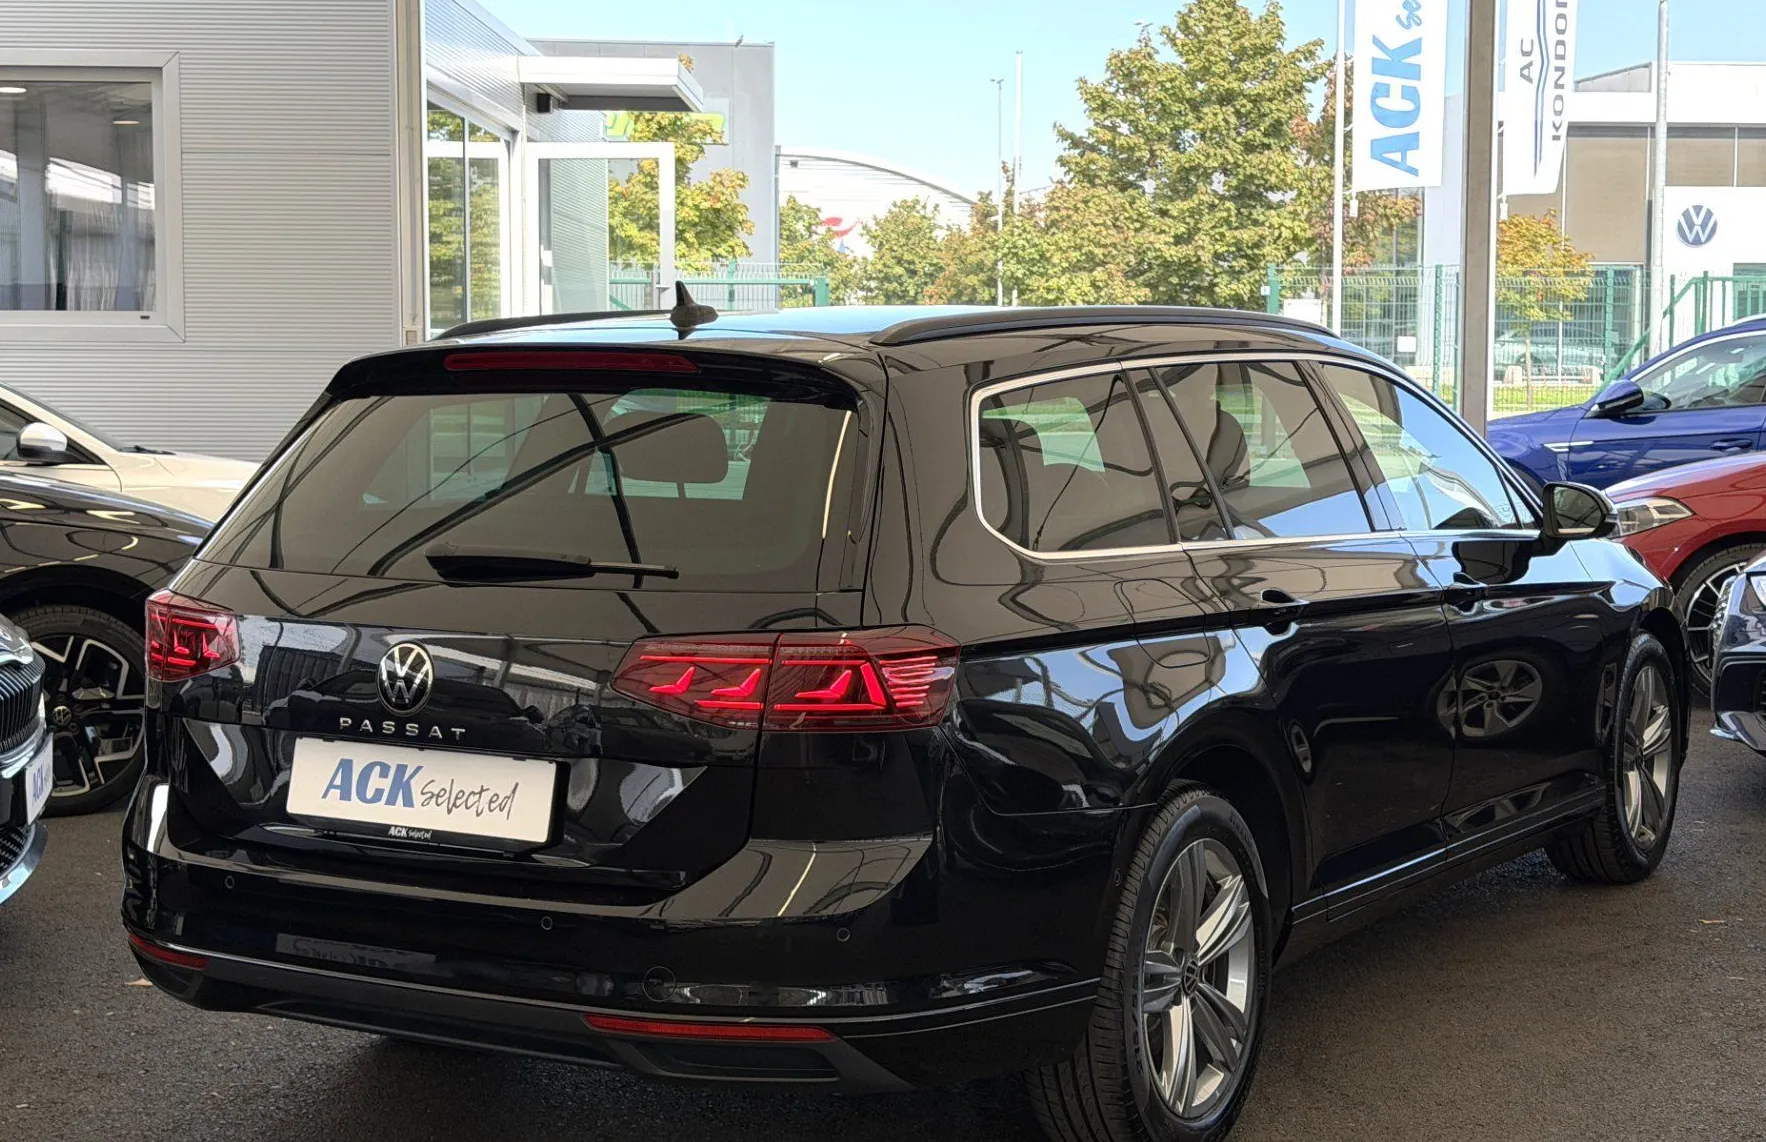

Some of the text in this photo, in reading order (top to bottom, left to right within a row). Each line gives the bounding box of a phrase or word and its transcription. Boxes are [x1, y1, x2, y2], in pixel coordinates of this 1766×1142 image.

[1519, 38, 1534, 84] AC
[1370, 34, 1422, 177] ACK
[1677, 204, 1718, 247] VW
[378, 642, 433, 714] VW
[339, 717, 466, 741] PASSAT
[321, 757, 519, 820] ACK Selected
[388, 826, 408, 838] ACK
